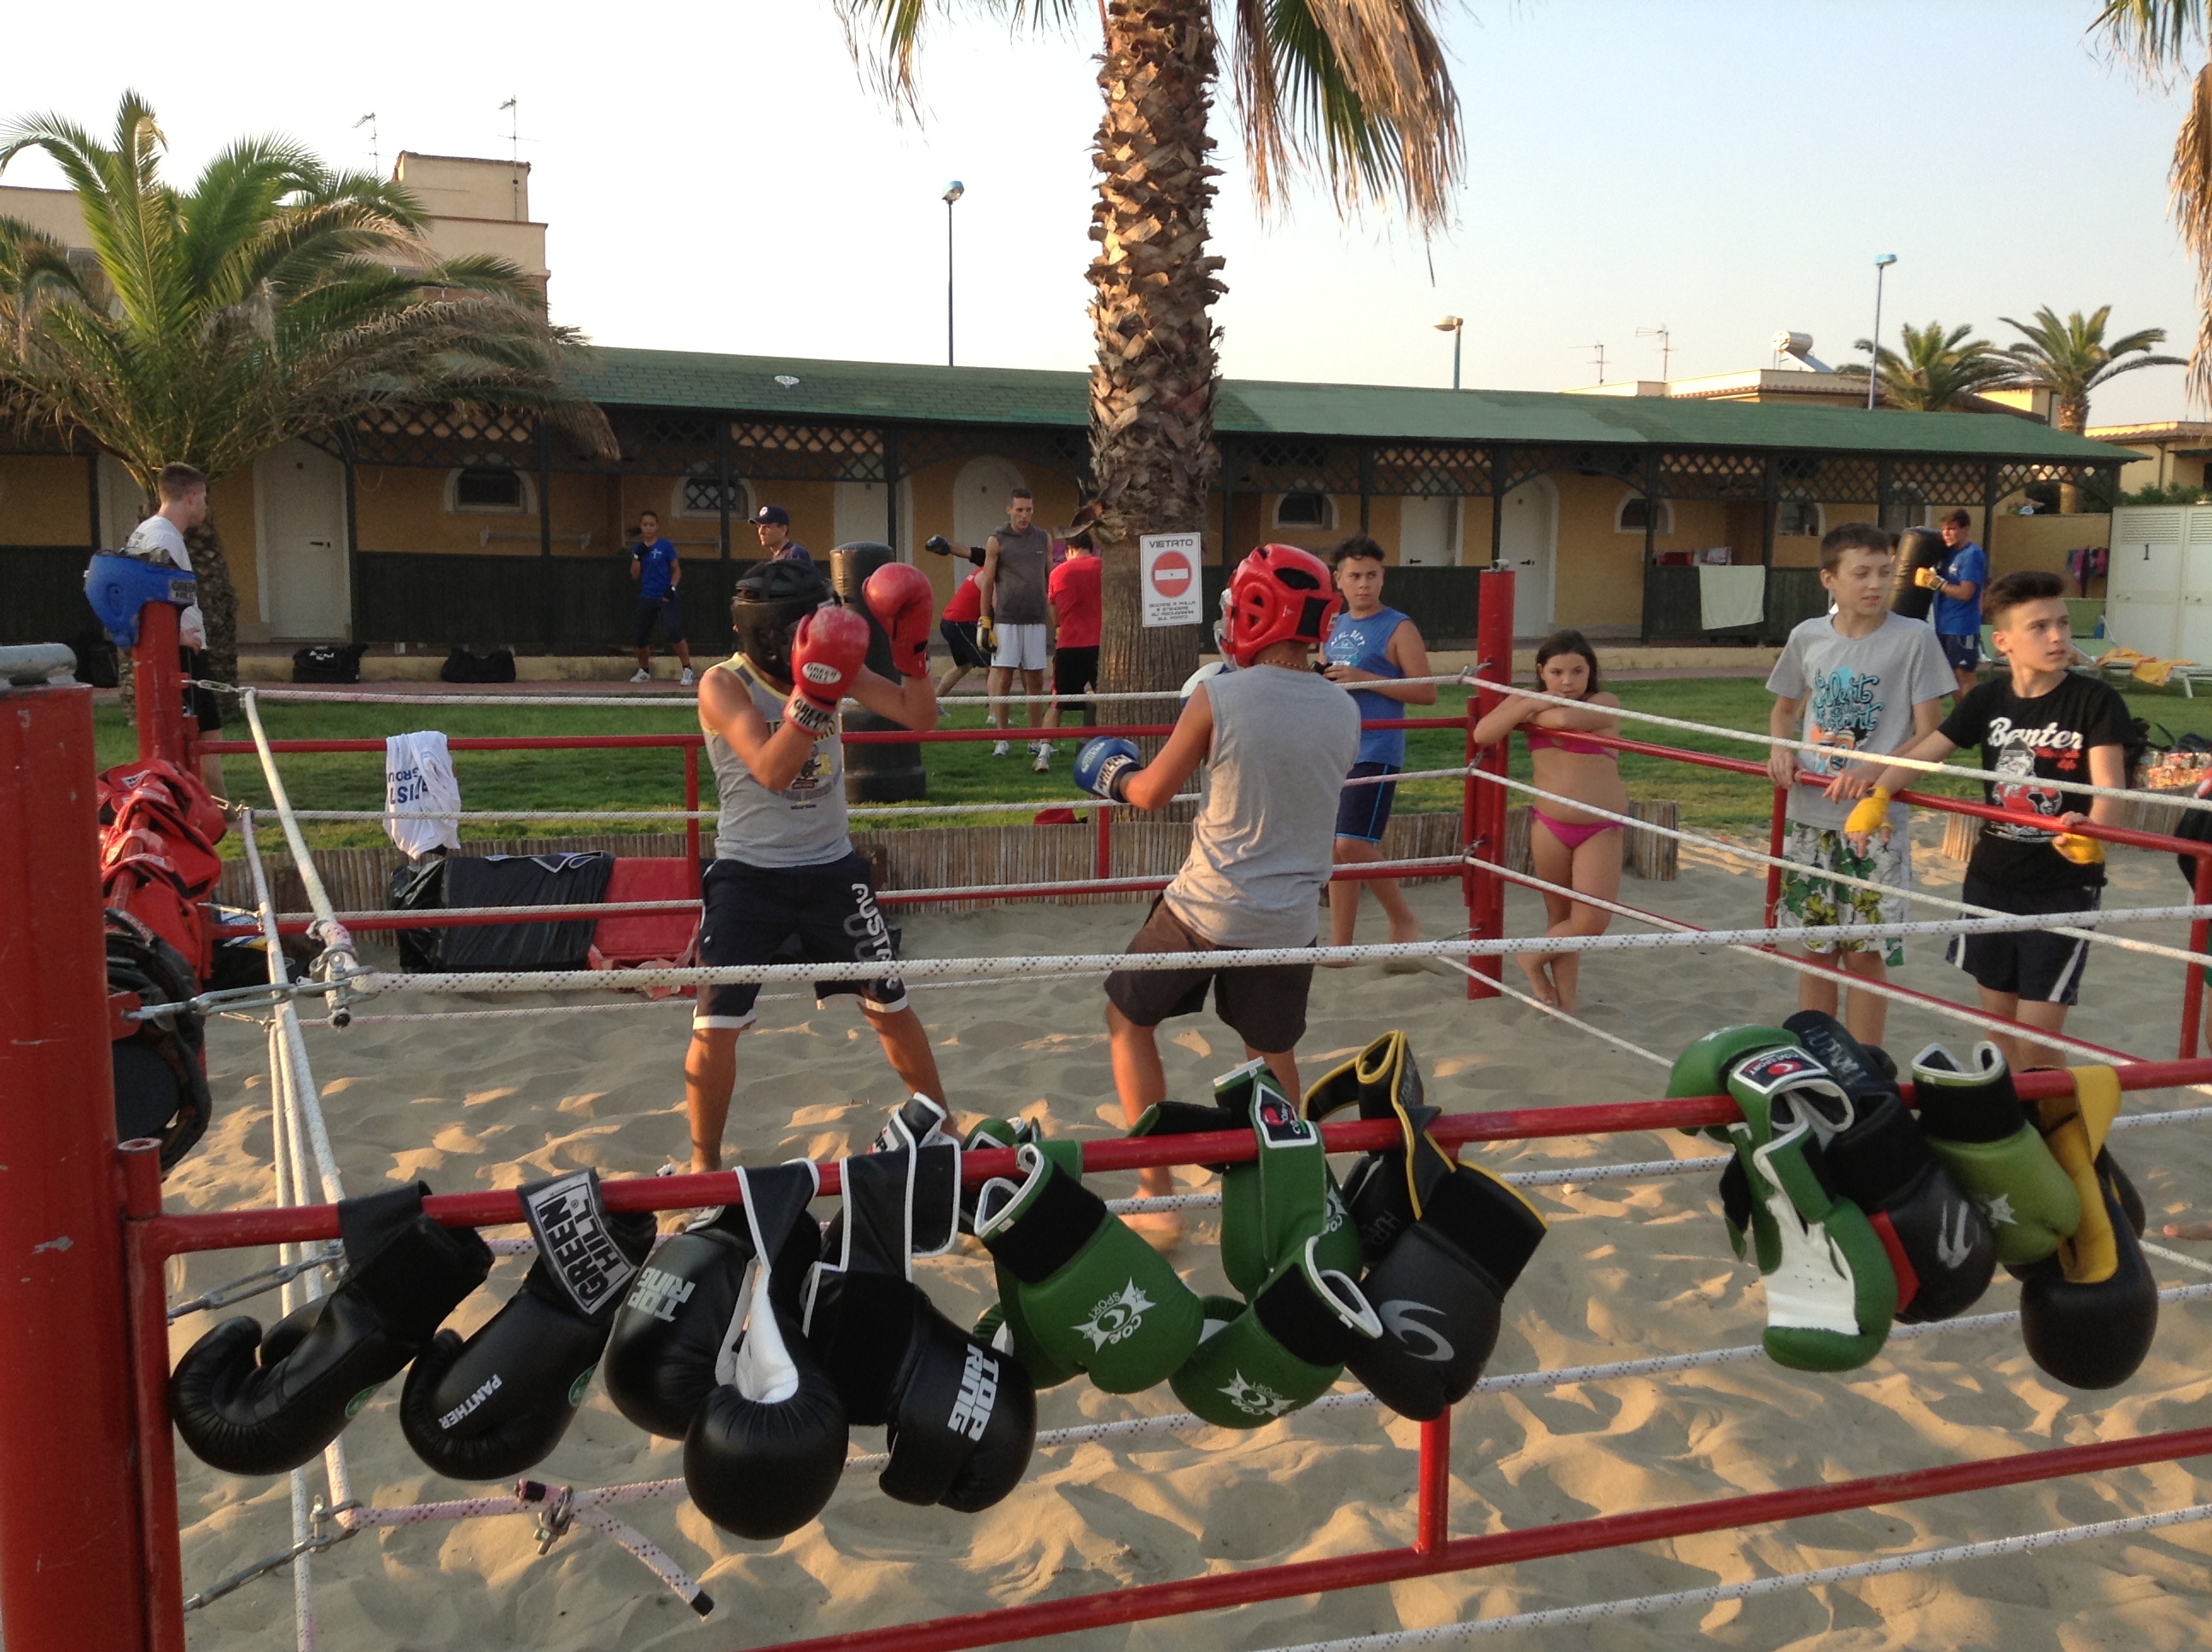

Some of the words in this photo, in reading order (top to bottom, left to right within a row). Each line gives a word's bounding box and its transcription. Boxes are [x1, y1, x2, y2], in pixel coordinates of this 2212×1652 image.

[1149, 538, 1194, 548] VIETATO
[2144, 543, 2150, 561] 1
[538, 1195, 609, 1300] GREEN
[574, 1198, 621, 1274] HILL
[627, 1287, 677, 1323] TOP
[637, 1266, 696, 1304] RING
[1087, 1291, 1121, 1320] SPORT
[438, 1373, 503, 1429] PANTHER
[947, 1342, 984, 1435] RING
[968, 1358, 999, 1442] TOP
